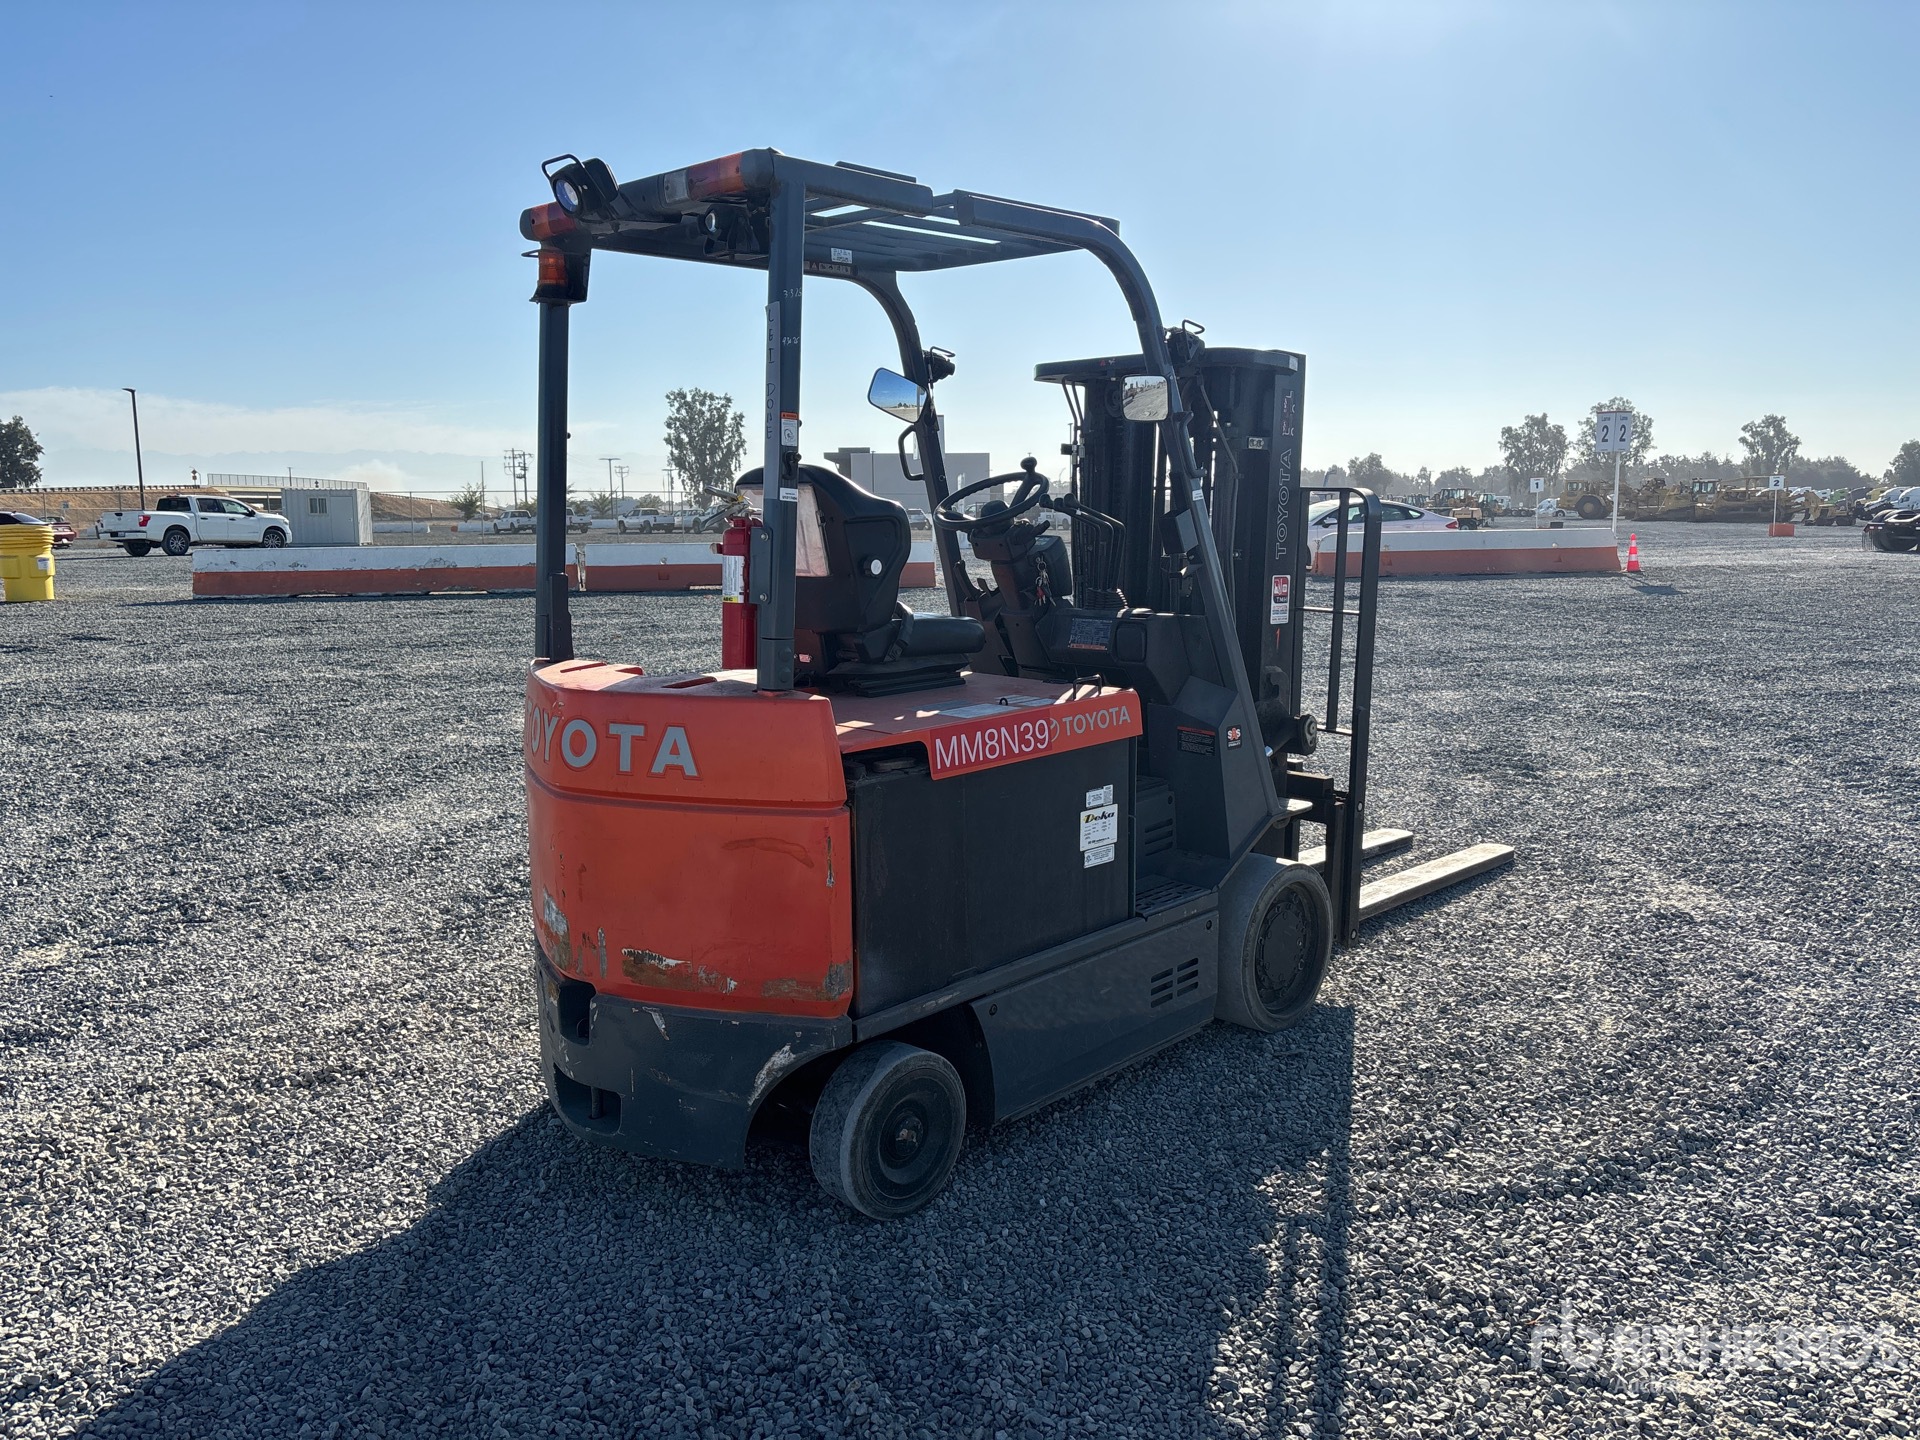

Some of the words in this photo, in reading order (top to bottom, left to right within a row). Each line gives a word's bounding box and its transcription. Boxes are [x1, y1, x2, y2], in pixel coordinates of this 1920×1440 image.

[1601, 424, 1609, 443] 2
[1618, 424, 1627, 442] 2
[1773, 479, 1780, 487] 2
[1275, 448, 1292, 560] TOYOTA
[1062, 705, 1131, 736] TOYOTA
[935, 719, 1050, 769] MM8N39
[1084, 811, 1115, 824] Deka
